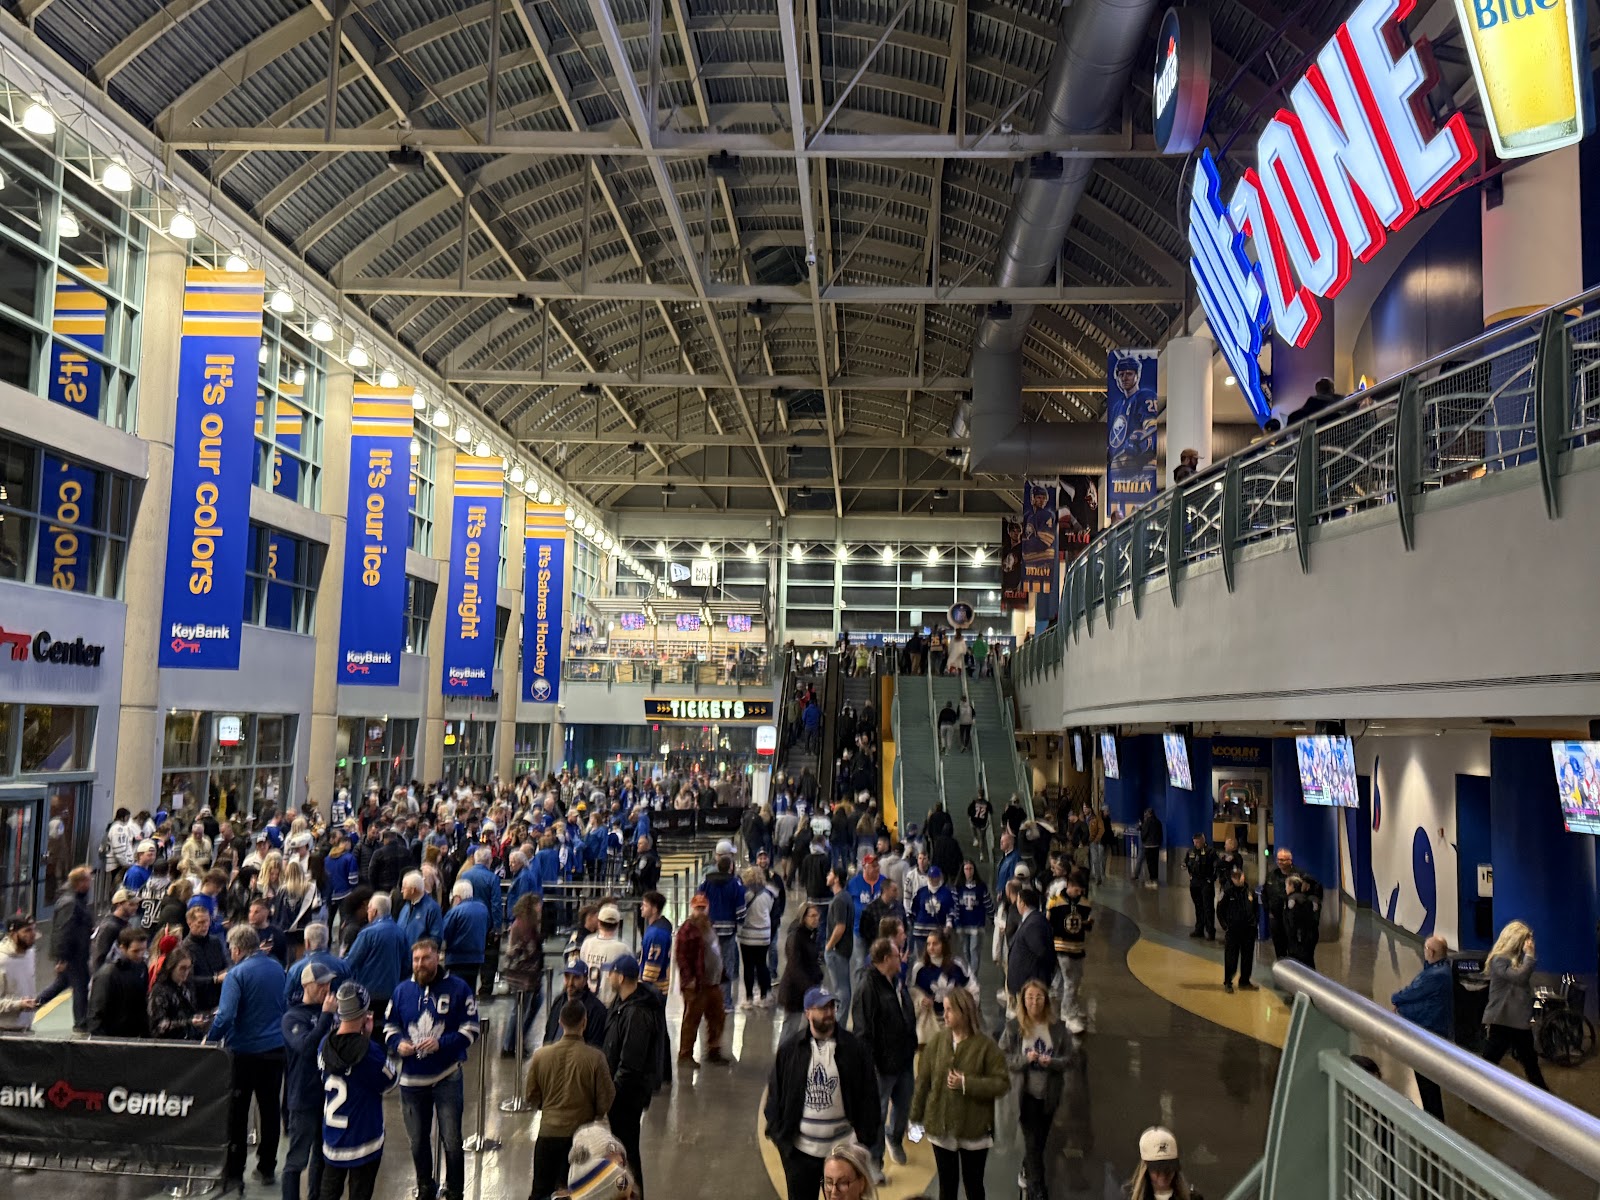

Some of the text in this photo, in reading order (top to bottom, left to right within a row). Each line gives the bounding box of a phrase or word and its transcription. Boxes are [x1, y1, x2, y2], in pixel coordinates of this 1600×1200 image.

[1228, 0, 1477, 348] ZONE
[189, 353, 235, 594] It's our colors
[362, 448, 393, 587] It's our ice
[458, 505, 487, 639] It's our night
[533, 545, 552, 677] It's Sabres Hockey
[171, 623, 231, 641] KeyBank
[32, 631, 105, 667] Center
[346, 650, 392, 665] KeyBank
[449, 667, 486, 679] KeyBank
[670, 700, 746, 719] TICKETS
[436, 993, 450, 1015] C
[107, 1086, 195, 1117] Center
